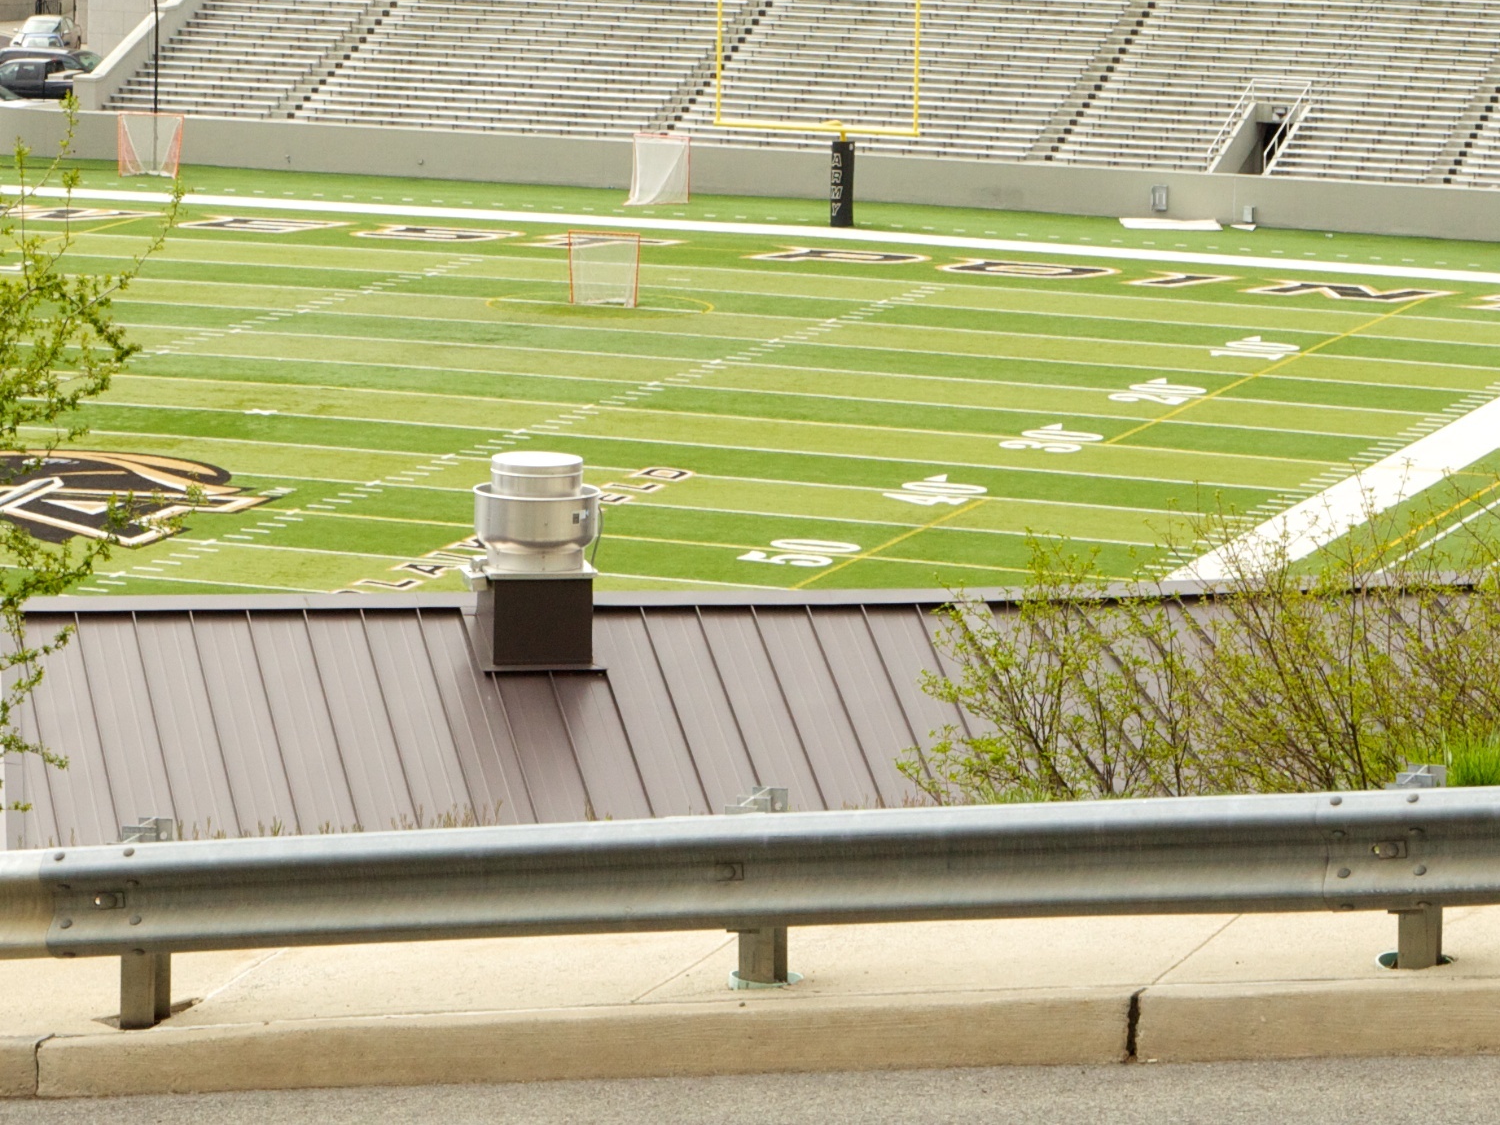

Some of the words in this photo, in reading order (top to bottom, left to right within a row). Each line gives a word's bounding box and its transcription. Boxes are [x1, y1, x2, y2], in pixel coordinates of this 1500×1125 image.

[831, 153, 843, 216] ARMY
[1210, 341, 1300, 360] 10
[1108, 383, 1207, 405] 20
[999, 429, 1104, 453] 30
[882, 482, 987, 505] 40
[737, 539, 861, 567] 50
